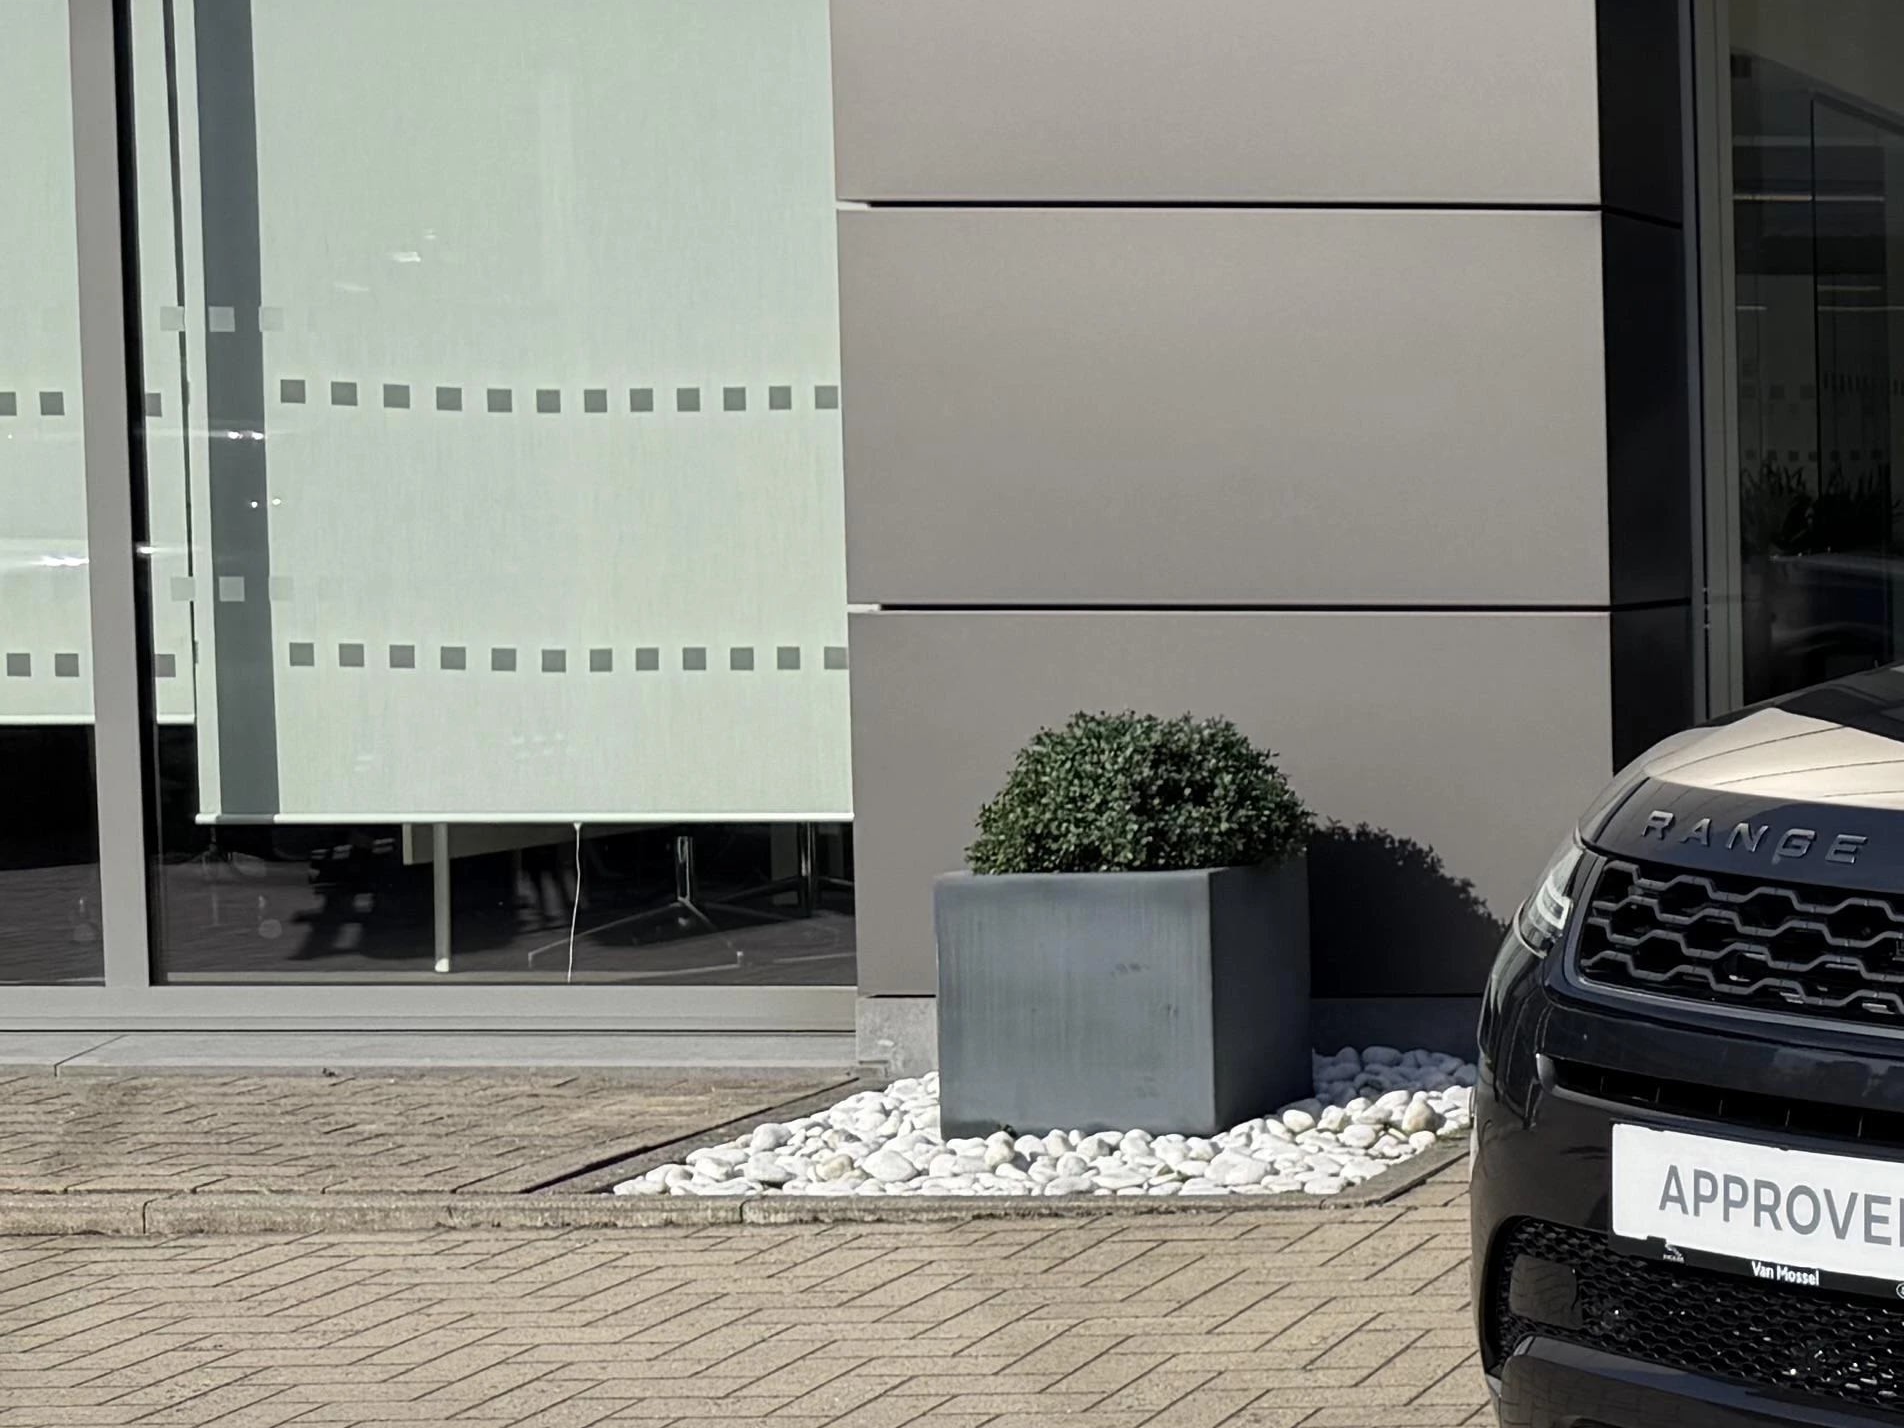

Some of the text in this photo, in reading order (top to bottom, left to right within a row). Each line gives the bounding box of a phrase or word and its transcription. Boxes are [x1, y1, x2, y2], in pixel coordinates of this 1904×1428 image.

[1640, 809, 1868, 865] RANGE
[1751, 1260, 1820, 1287] Van Mossel
